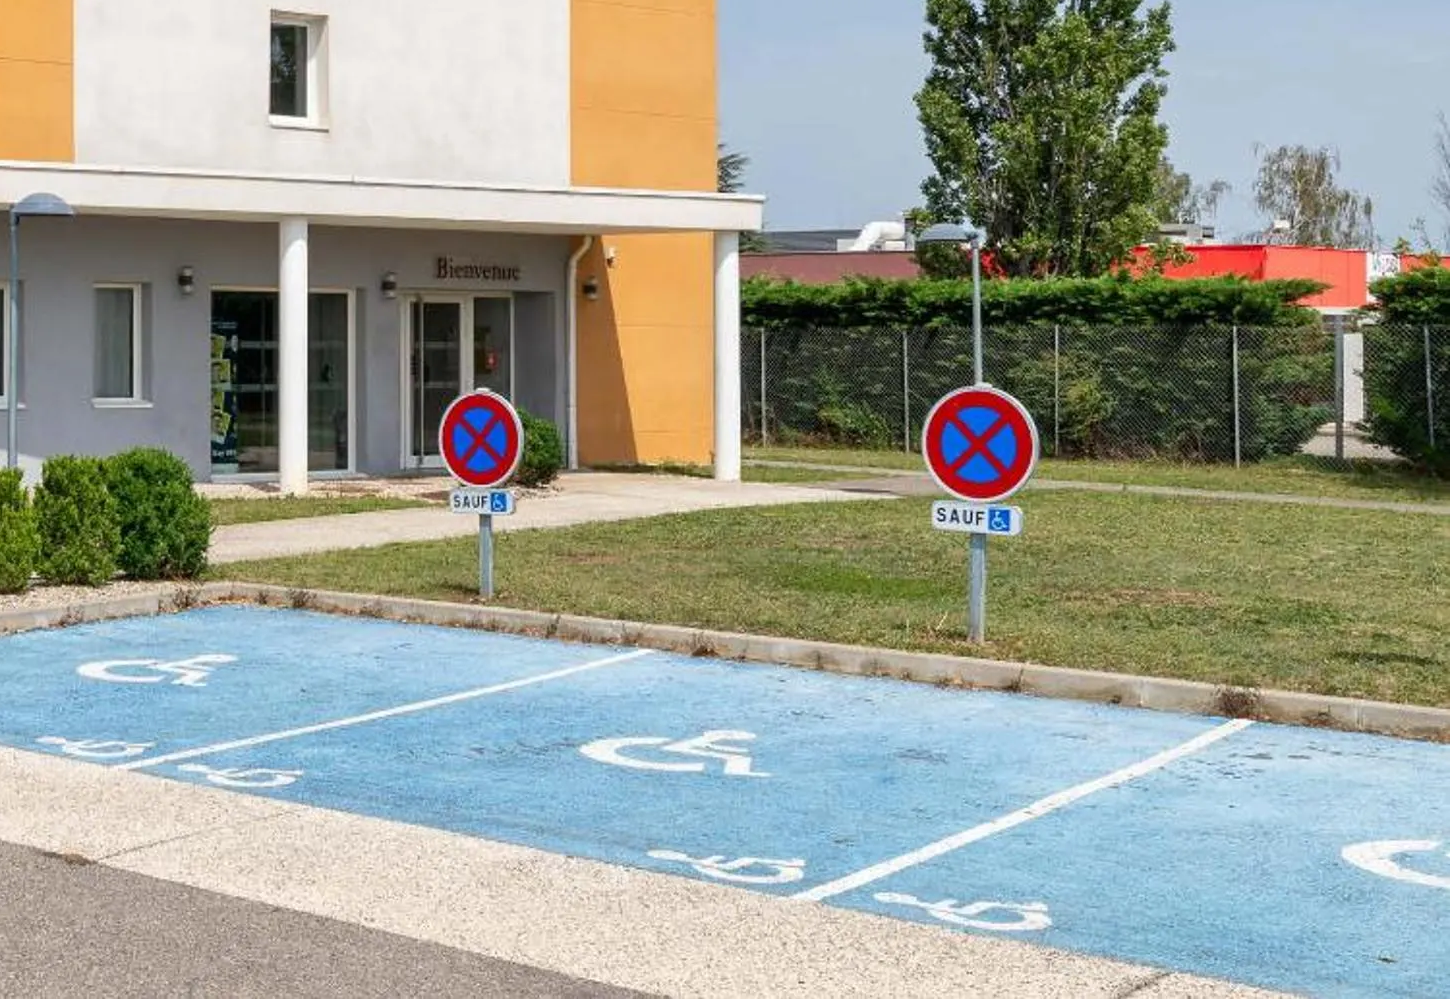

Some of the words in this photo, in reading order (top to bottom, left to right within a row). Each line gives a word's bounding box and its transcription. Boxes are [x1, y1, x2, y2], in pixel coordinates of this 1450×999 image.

[436, 256, 520, 281] Bienvenue
[453, 494, 488, 509] SAUF
[936, 507, 985, 526] SAUF
